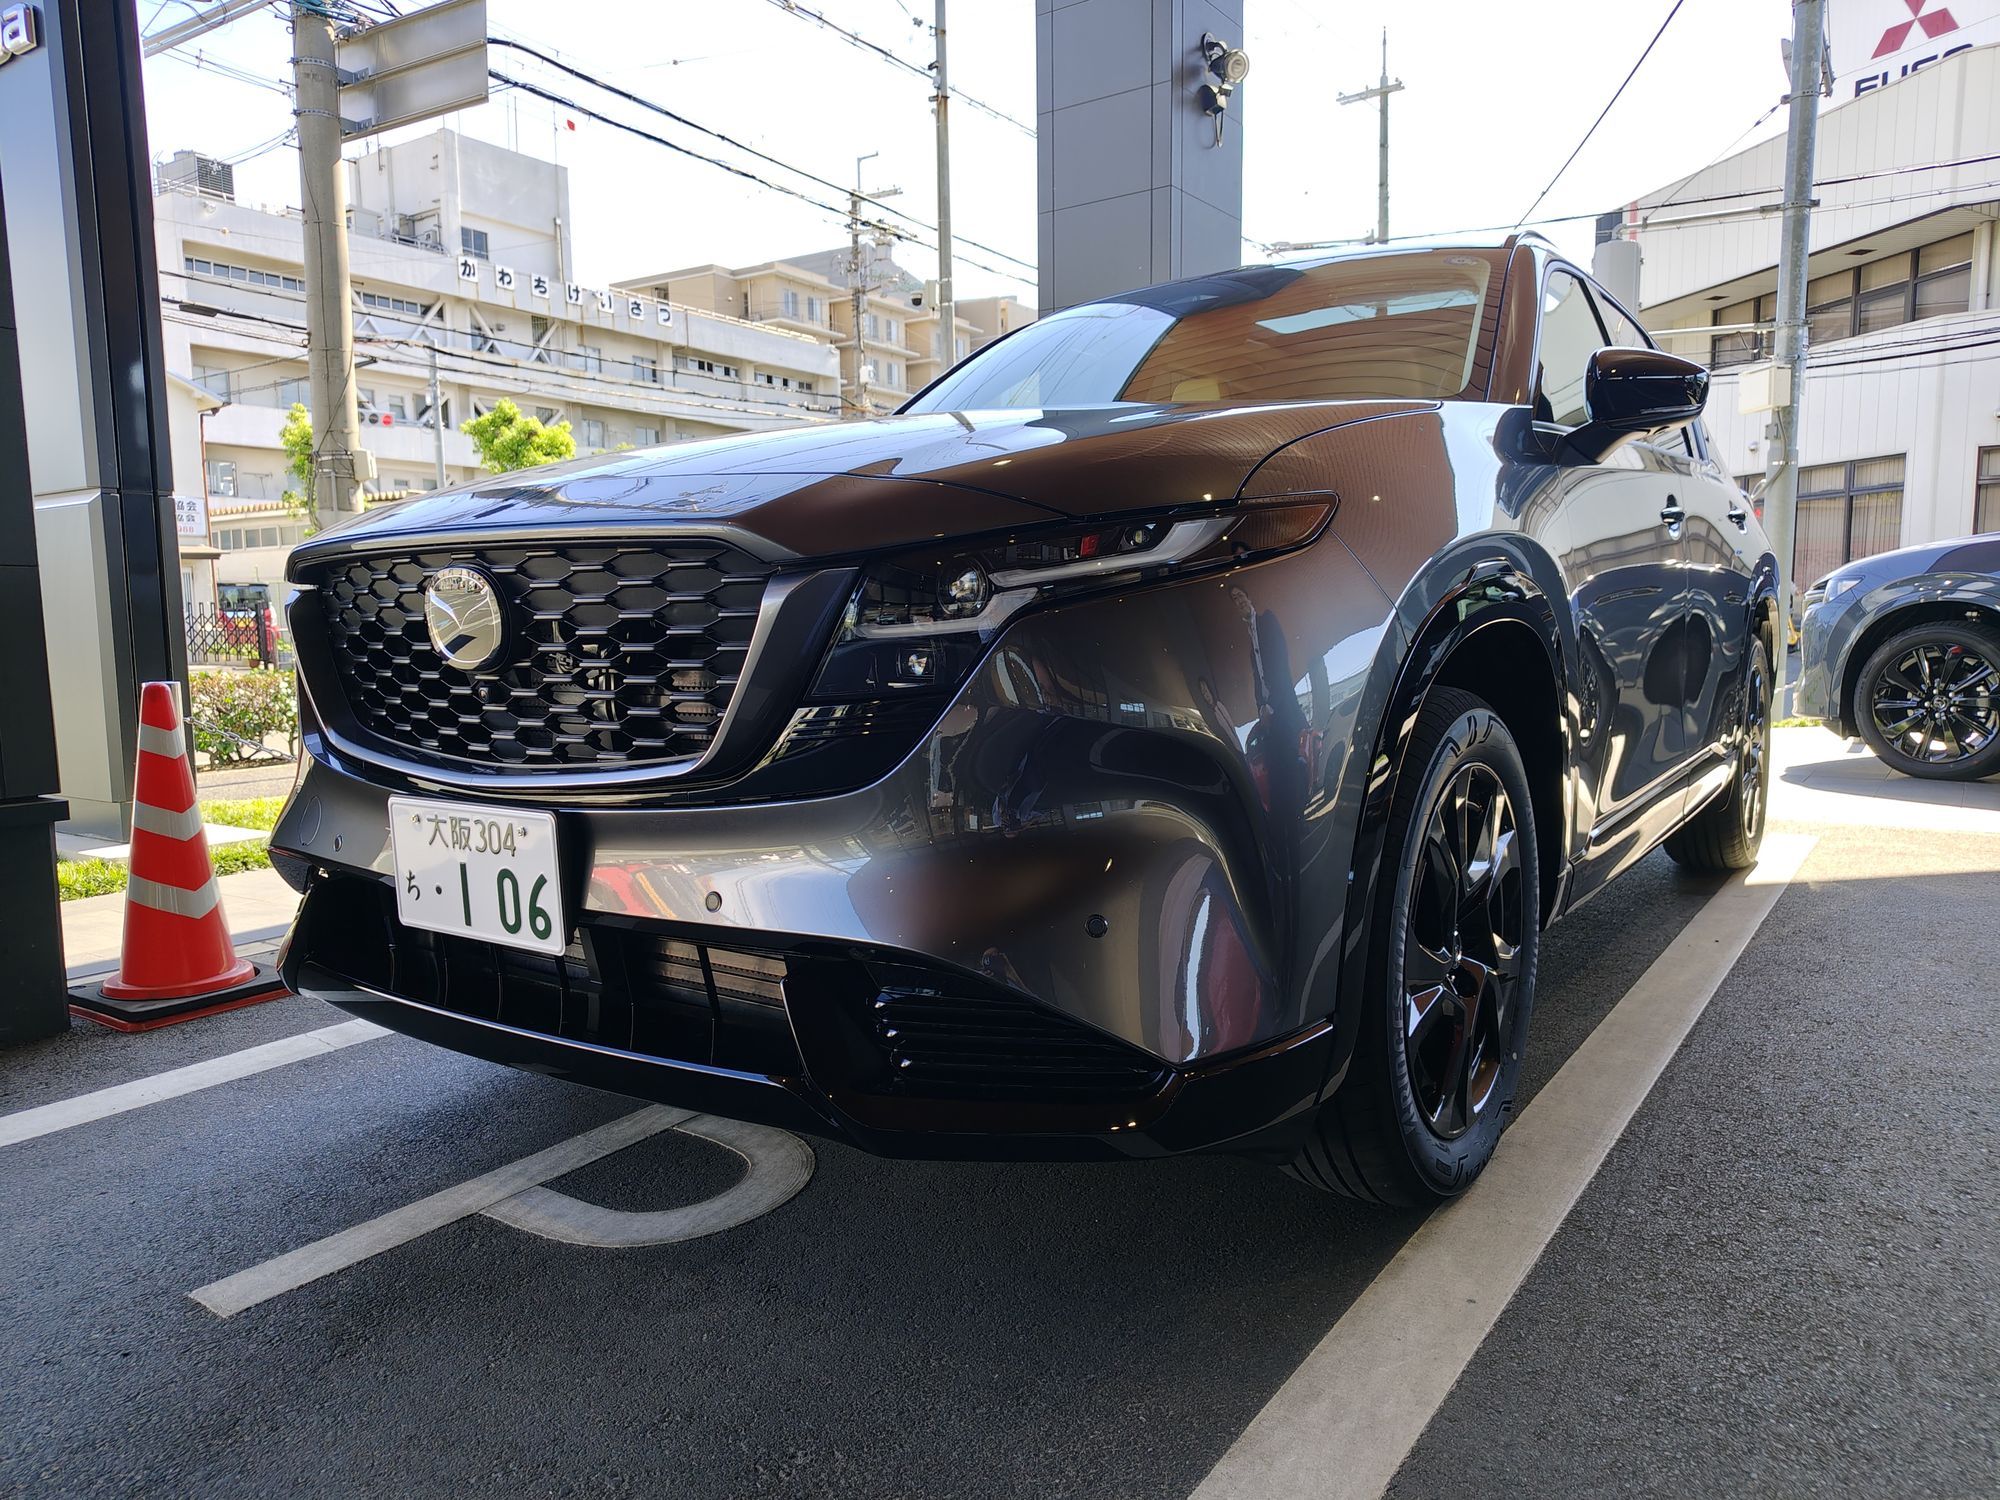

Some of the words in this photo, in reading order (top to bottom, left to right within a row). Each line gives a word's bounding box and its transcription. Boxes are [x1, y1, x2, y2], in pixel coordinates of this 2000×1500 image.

[0, 2, 37, 66] a
[1854, 43, 1973, 98] FU
[460, 259, 671, 323] かわちけいさつ
